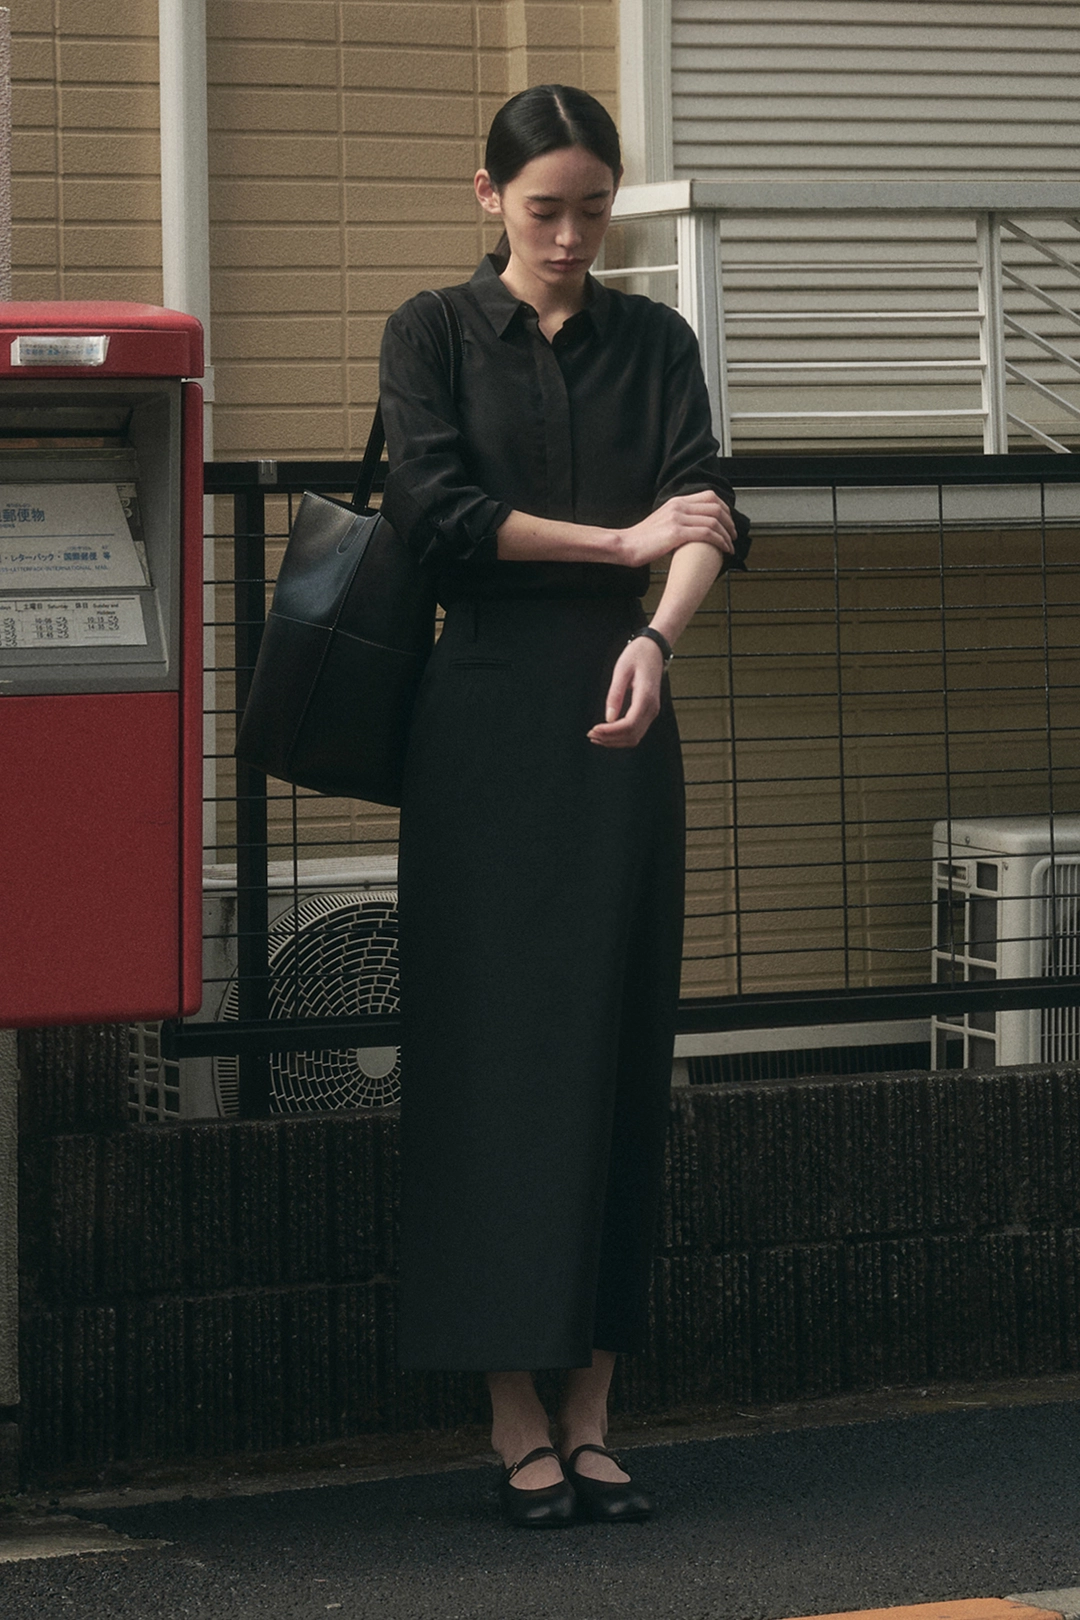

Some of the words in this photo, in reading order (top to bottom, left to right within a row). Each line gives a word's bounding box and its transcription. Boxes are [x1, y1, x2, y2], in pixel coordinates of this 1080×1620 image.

[0, 508, 46, 523] 郵便物
[23, 602, 43, 610] 土曜日
